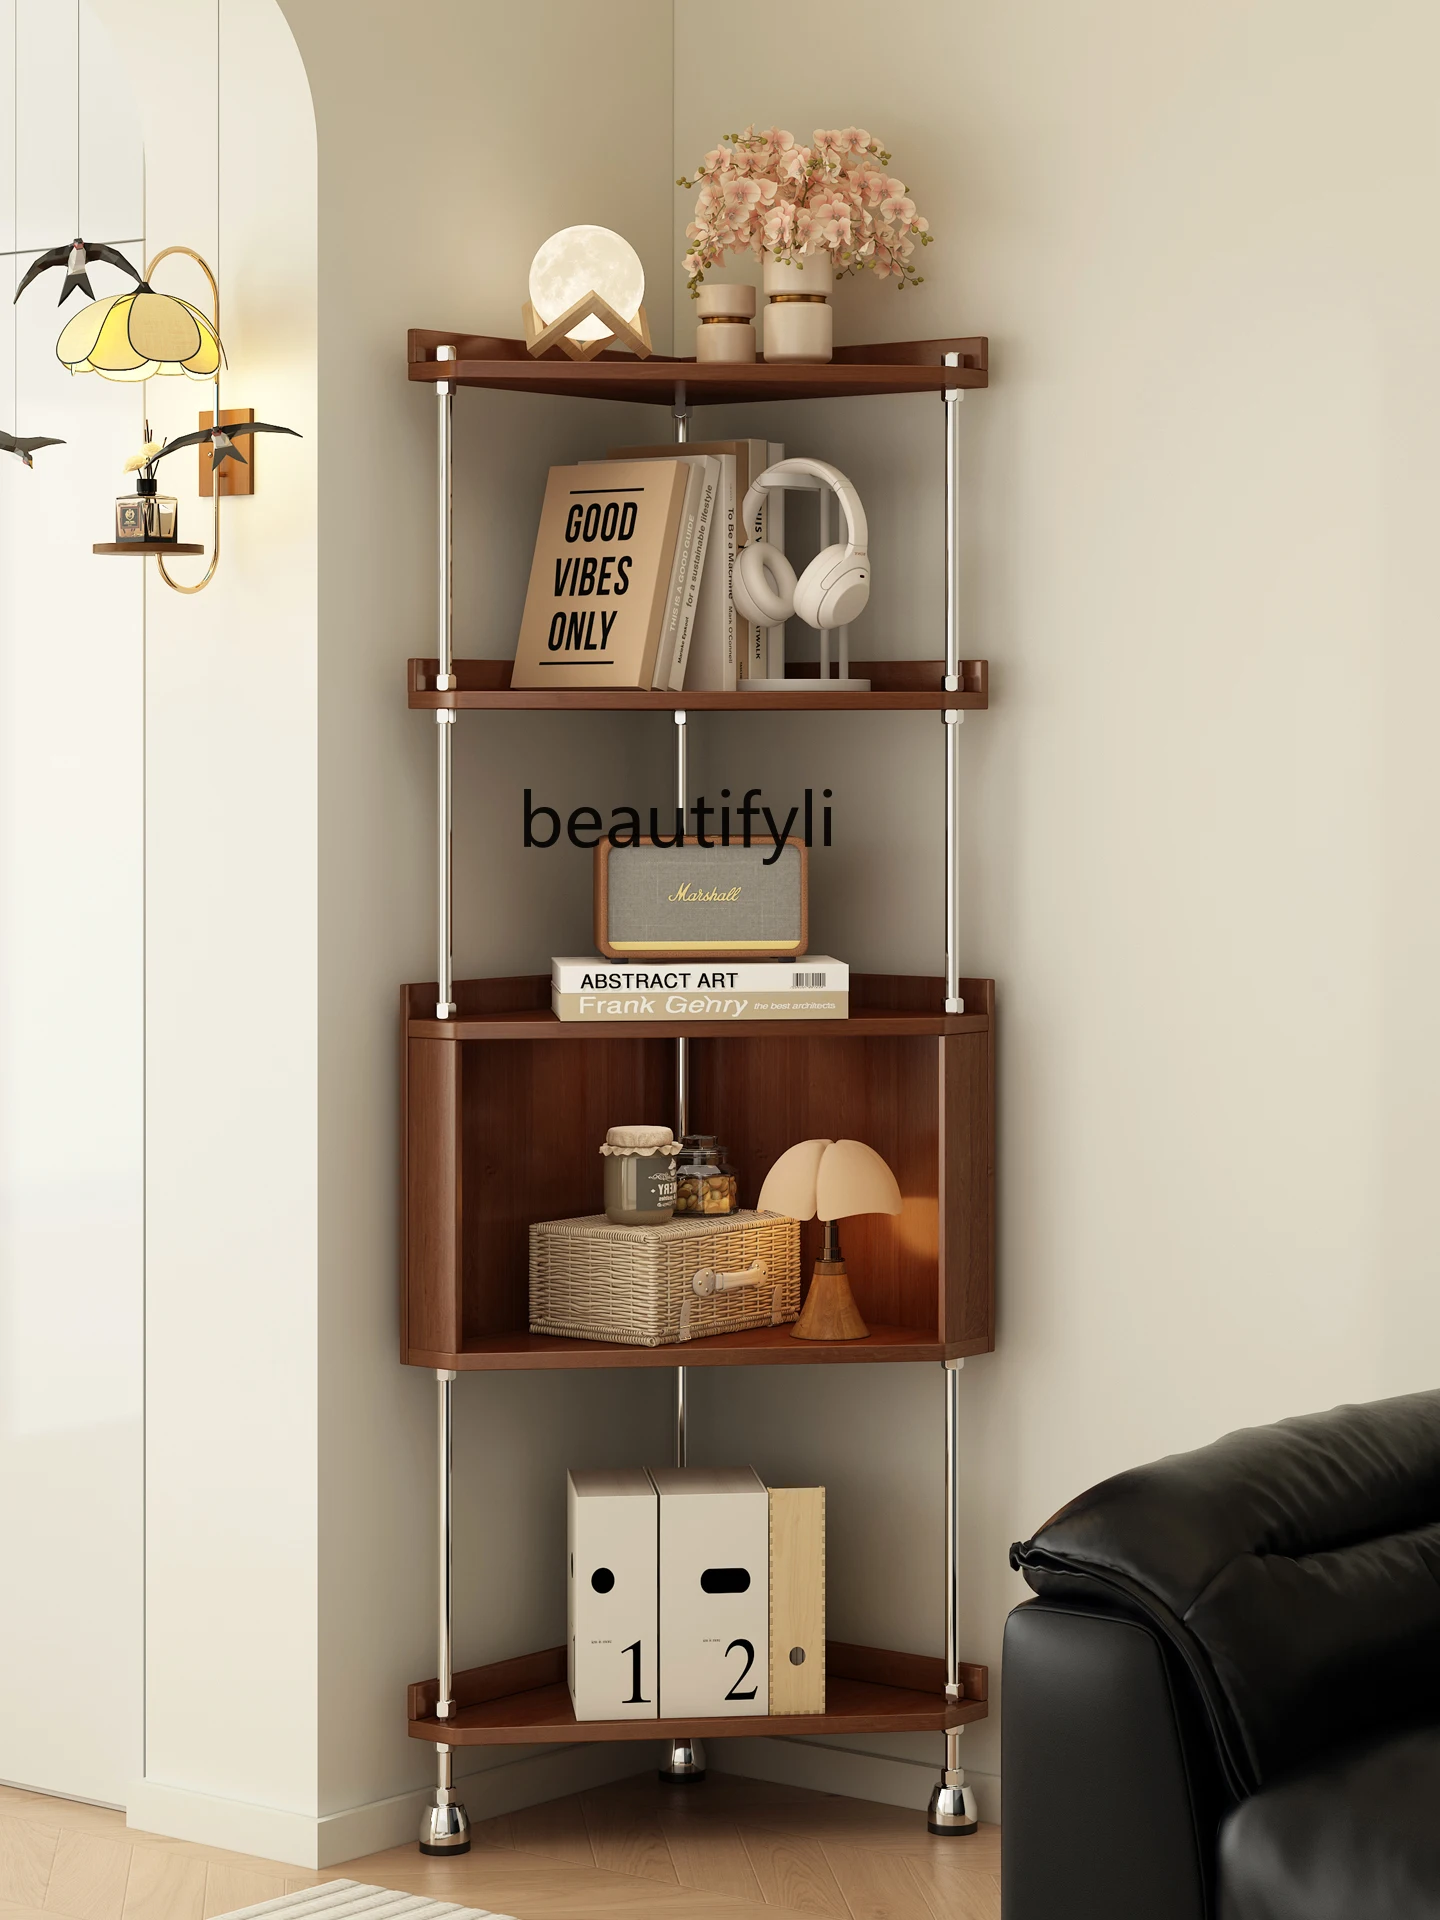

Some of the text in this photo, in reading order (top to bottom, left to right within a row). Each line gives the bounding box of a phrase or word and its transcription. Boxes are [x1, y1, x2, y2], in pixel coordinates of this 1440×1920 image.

[565, 502, 638, 543] GOOD
[727, 508, 735, 520] To
[727, 524, 735, 539] Be
[686, 593, 694, 608] for
[691, 525, 706, 582] sustainable
[700, 484, 713, 523] lifestyle
[554, 555, 633, 597] VIBES
[669, 514, 695, 632] THIS IS A GOOD GUIDE
[548, 610, 618, 651] ONLY
[668, 882, 742, 902] Marshall
[580, 972, 739, 989] ABSTRACT ART
[579, 995, 656, 1014] Frank
[754, 1001, 836, 1010] the best architects
[621, 1639, 652, 1704] 1
[724, 1638, 759, 1701] 2
